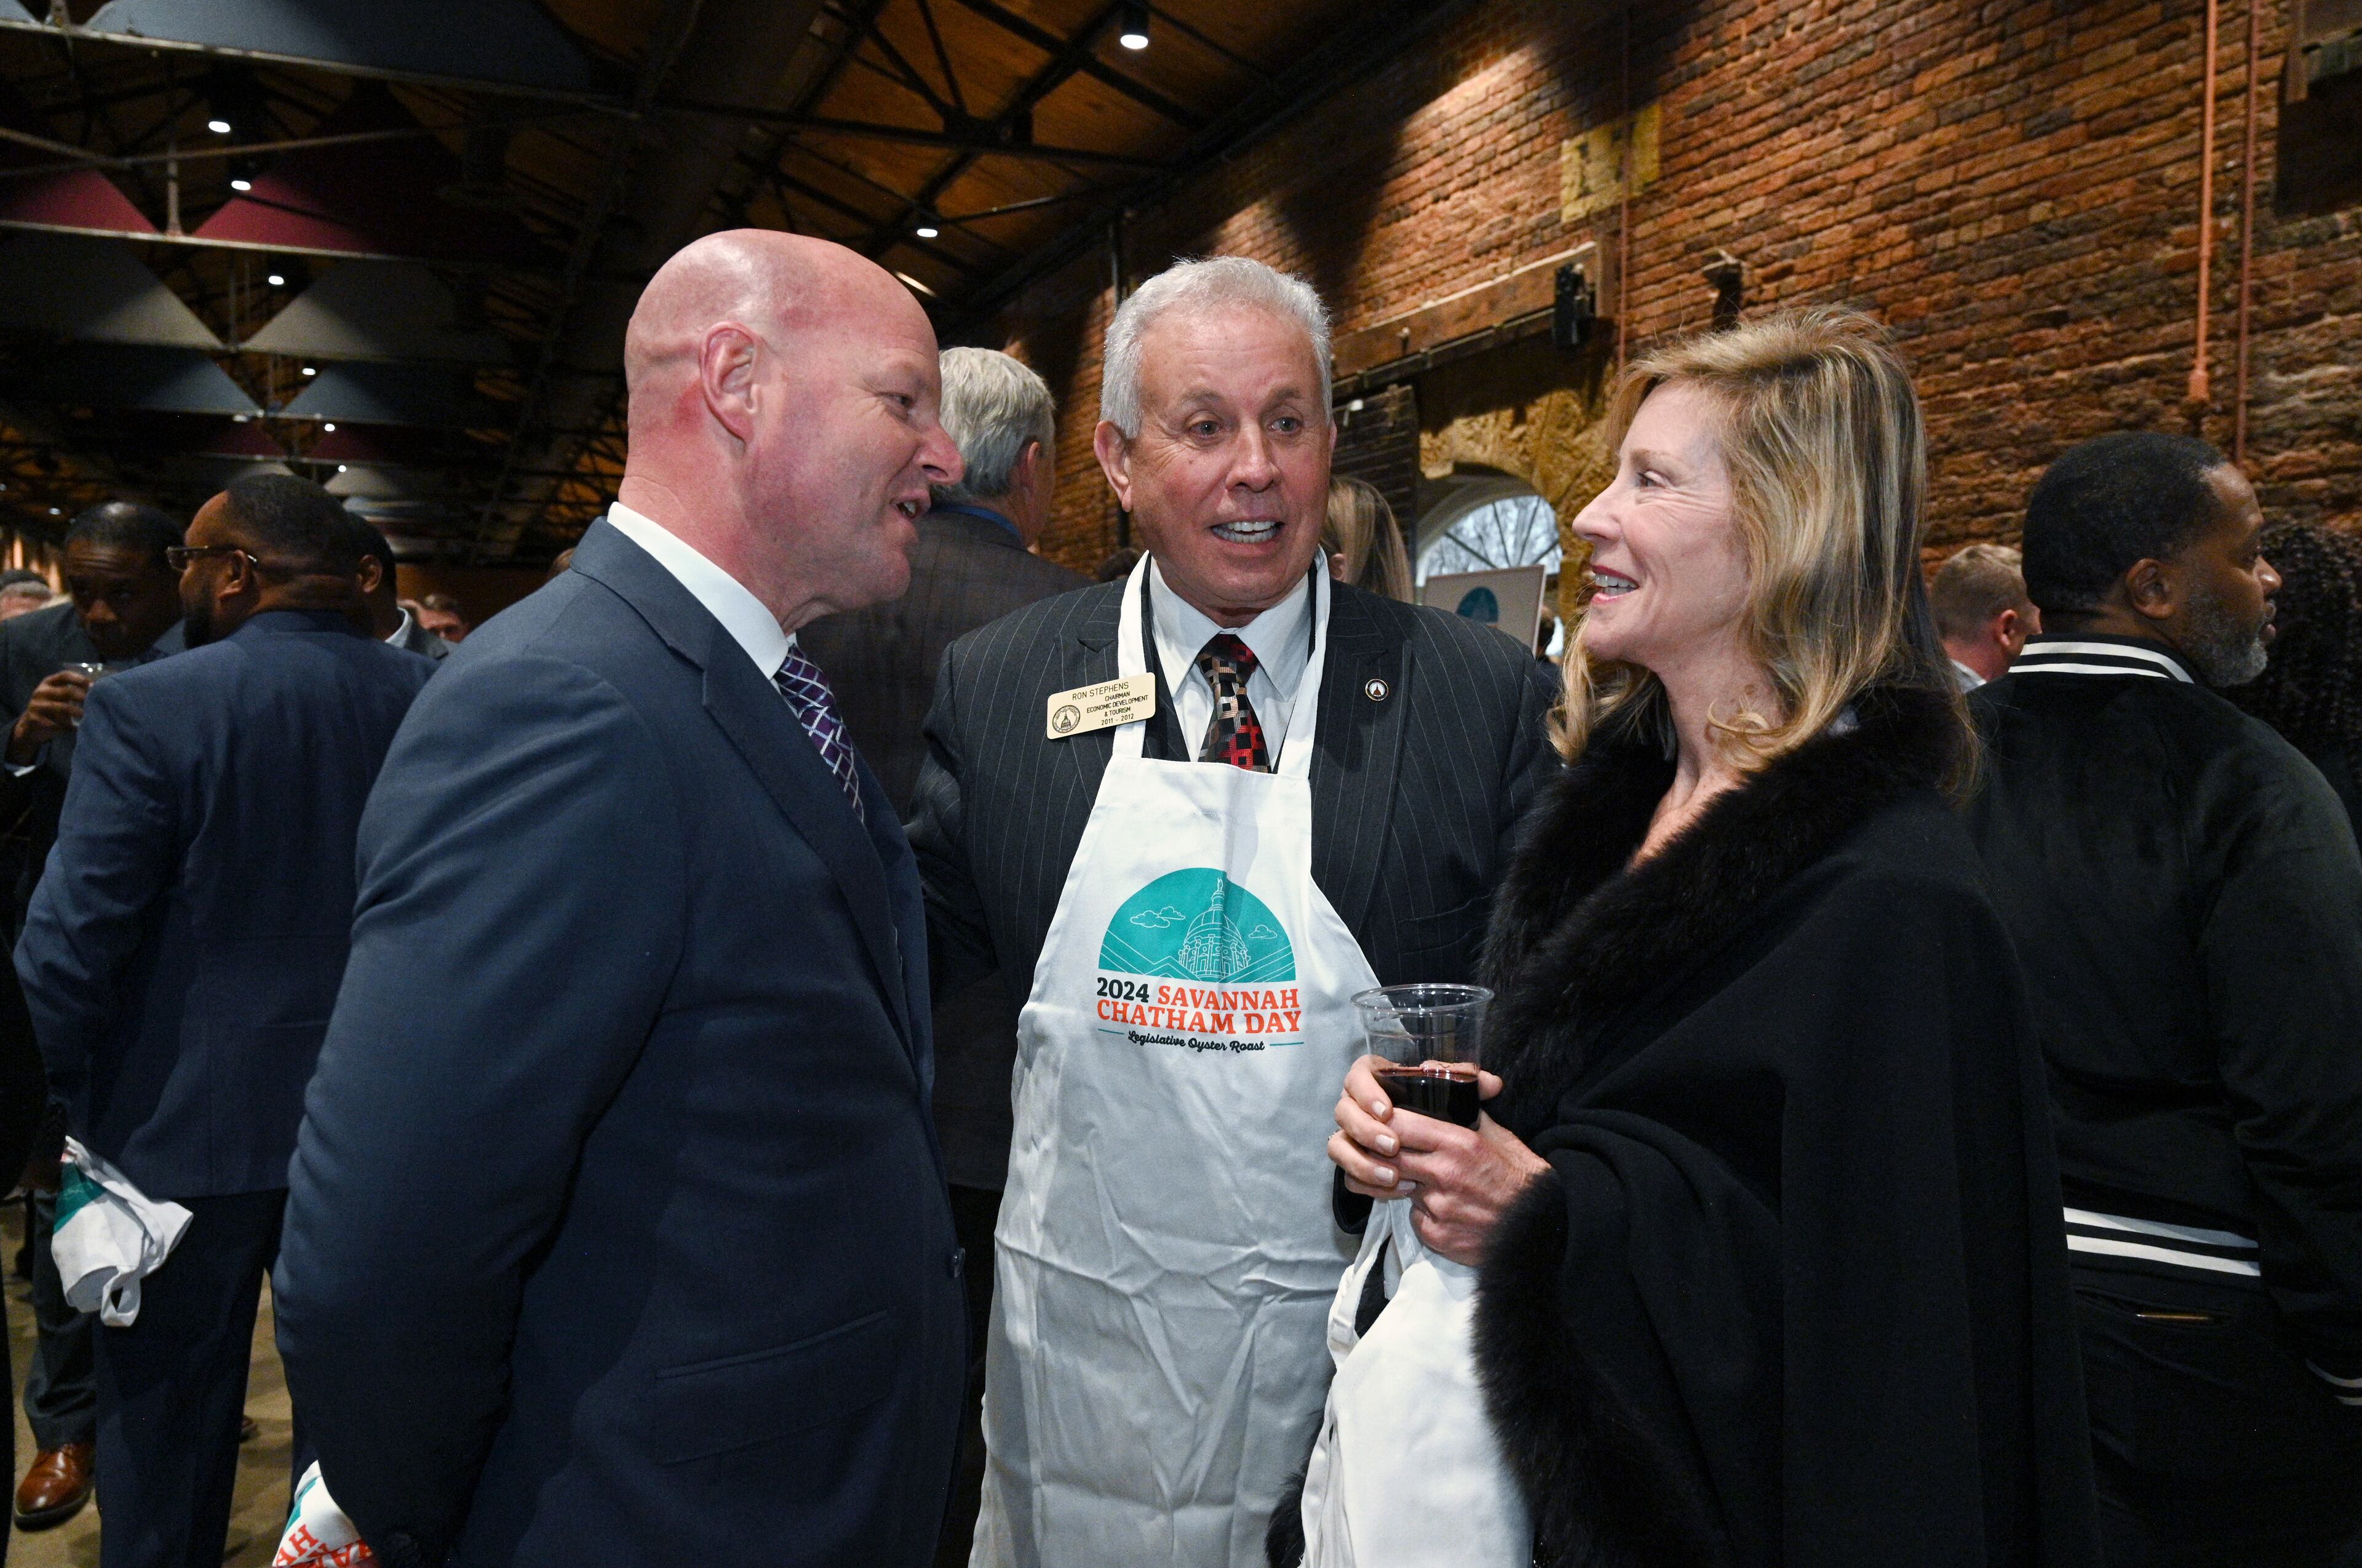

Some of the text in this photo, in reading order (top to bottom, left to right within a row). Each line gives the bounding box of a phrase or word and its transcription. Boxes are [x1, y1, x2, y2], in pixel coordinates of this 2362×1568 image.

[1072, 682, 1129, 701] RON STEPHENS
[1105, 691, 1131, 702] CHAIRMAN
[1086, 695, 1148, 714] ECONOMIC DEVELOPMENT
[1110, 706, 1131, 715] TOURISM
[1097, 977, 1300, 1011] 2024 SAVANNAH
[1097, 999, 1302, 1034] CHATHAM DAY
[1127, 1030, 1265, 1053] Legislative Oyster Roast
